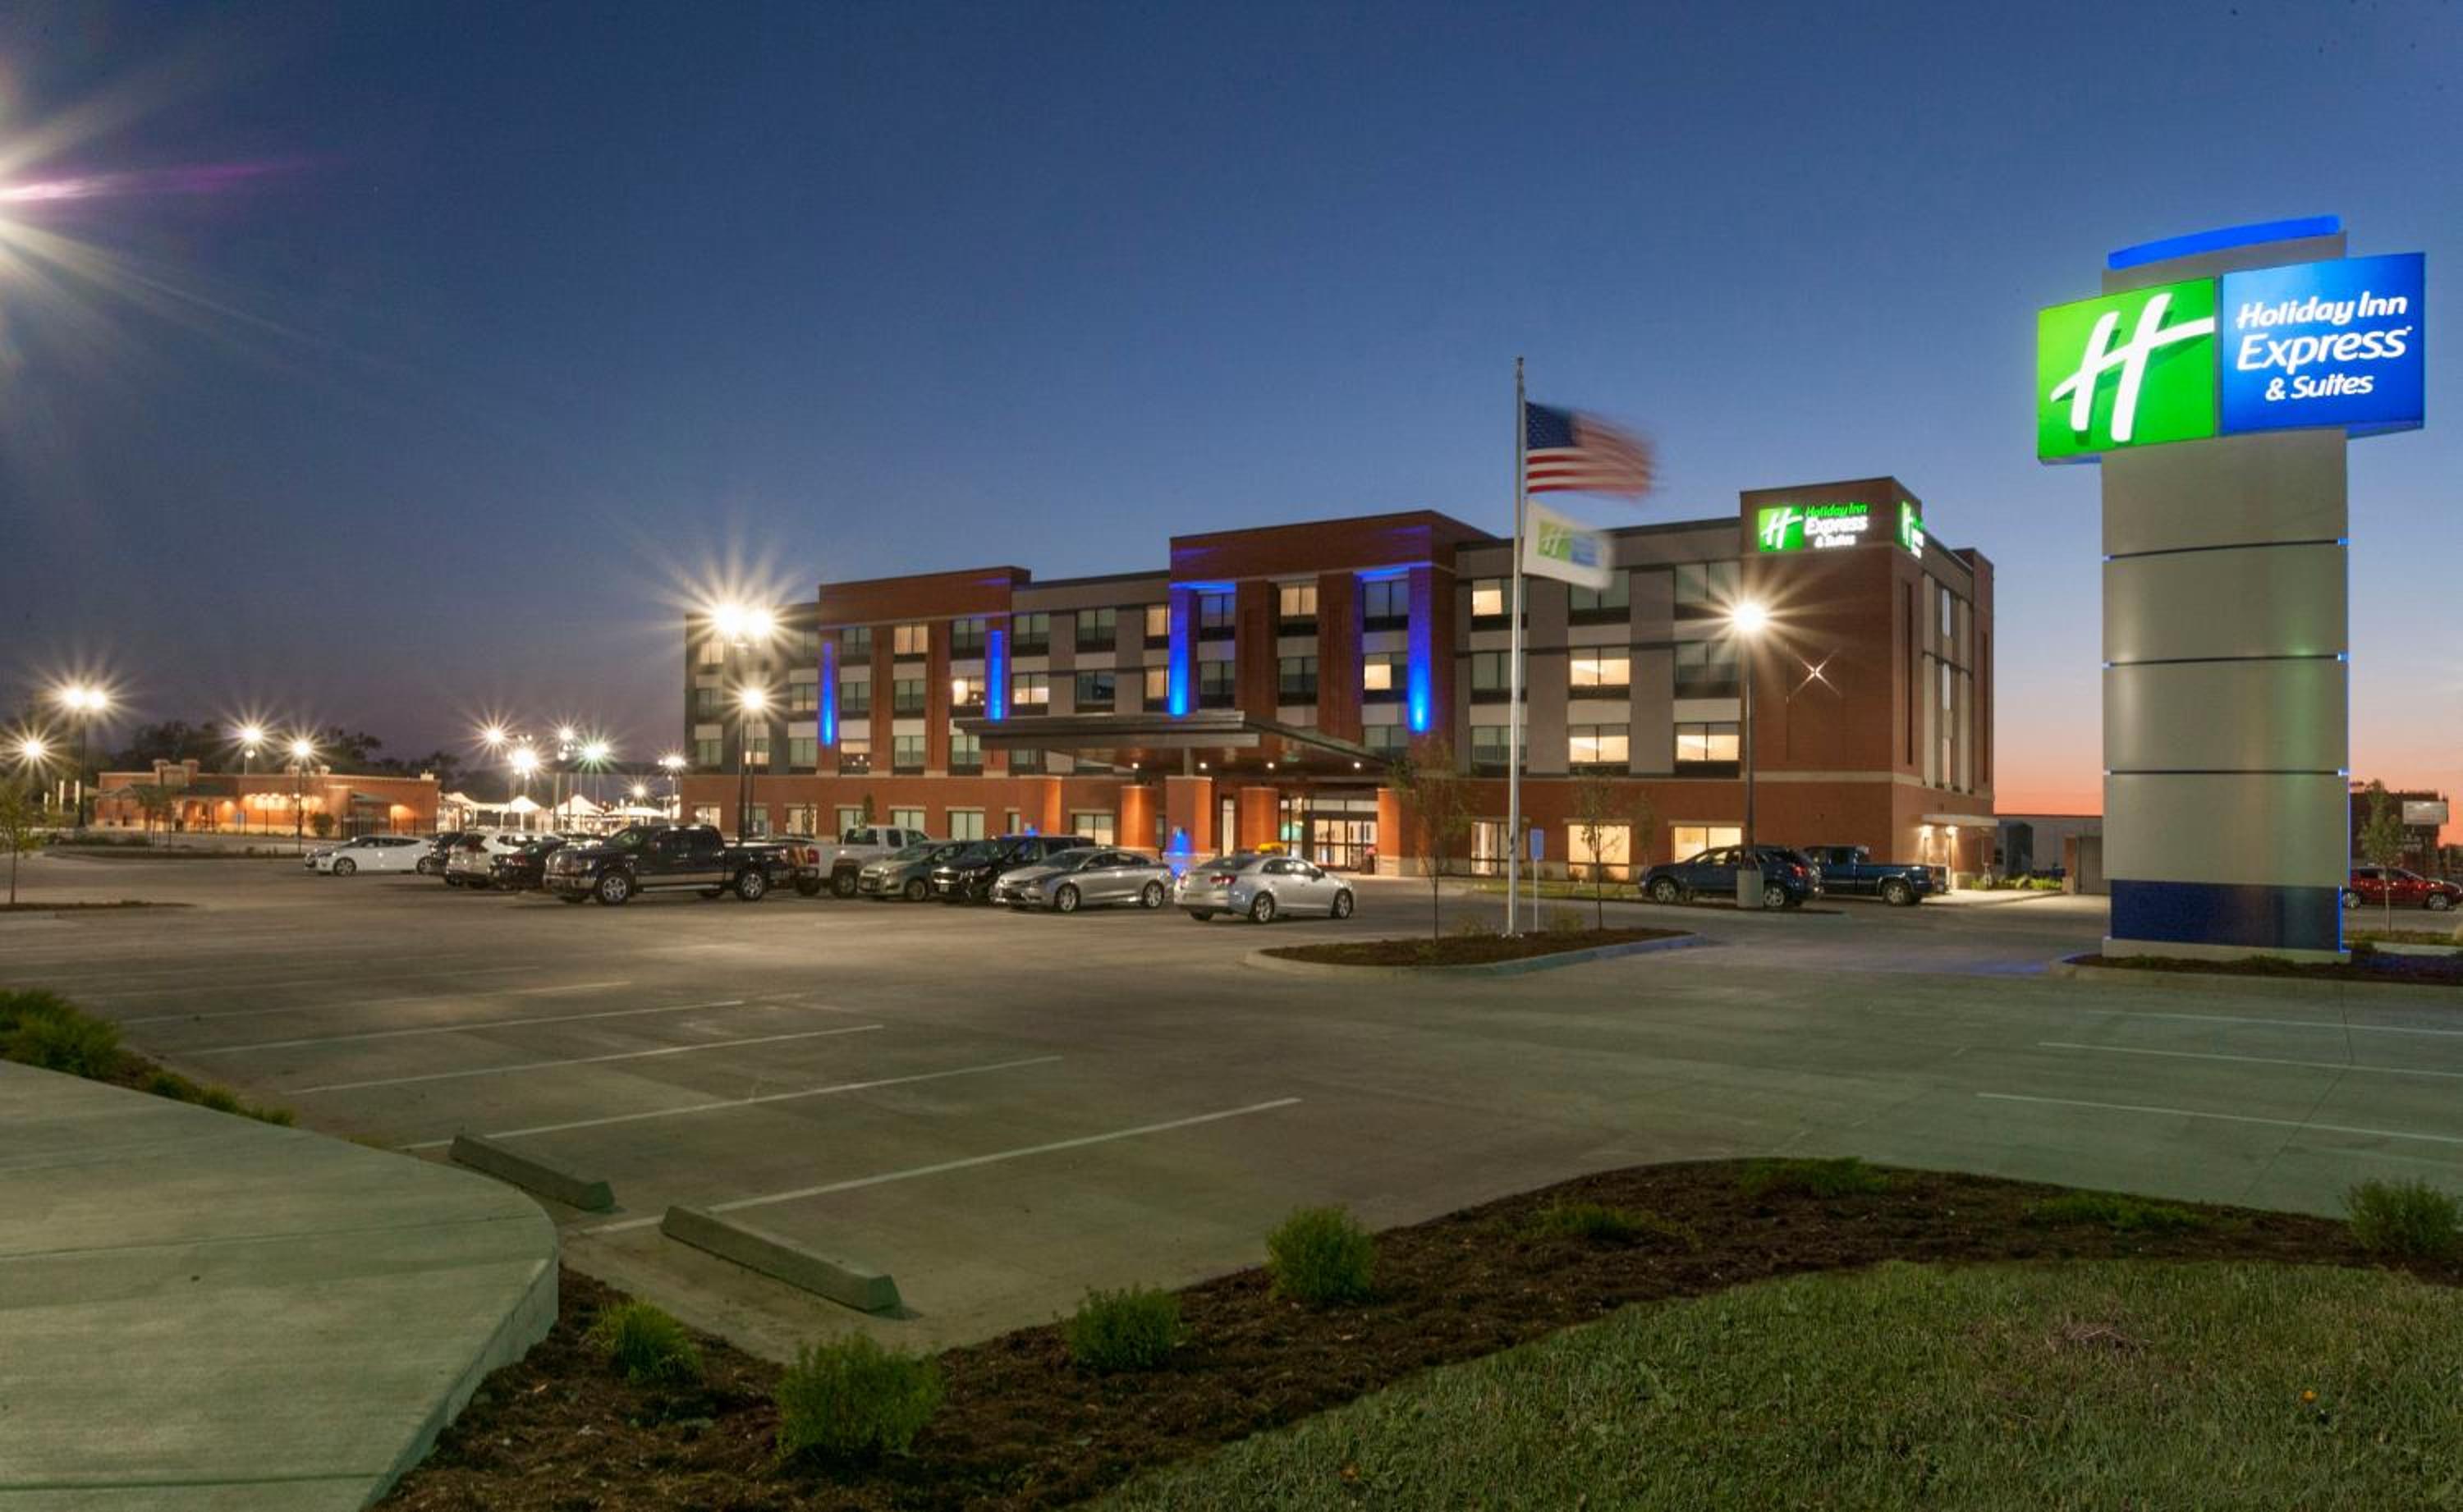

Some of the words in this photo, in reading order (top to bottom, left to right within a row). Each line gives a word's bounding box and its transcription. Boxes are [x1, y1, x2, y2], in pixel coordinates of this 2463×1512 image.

[2236, 296, 2355, 328] Holiday
[2357, 291, 2408, 318] Inn
[2236, 328, 2409, 375] Express
[2264, 377, 2286, 401] &
[2290, 372, 2375, 399] Suites
[1806, 503, 1848, 519] Holiday
[1849, 502, 1868, 515] Inn
